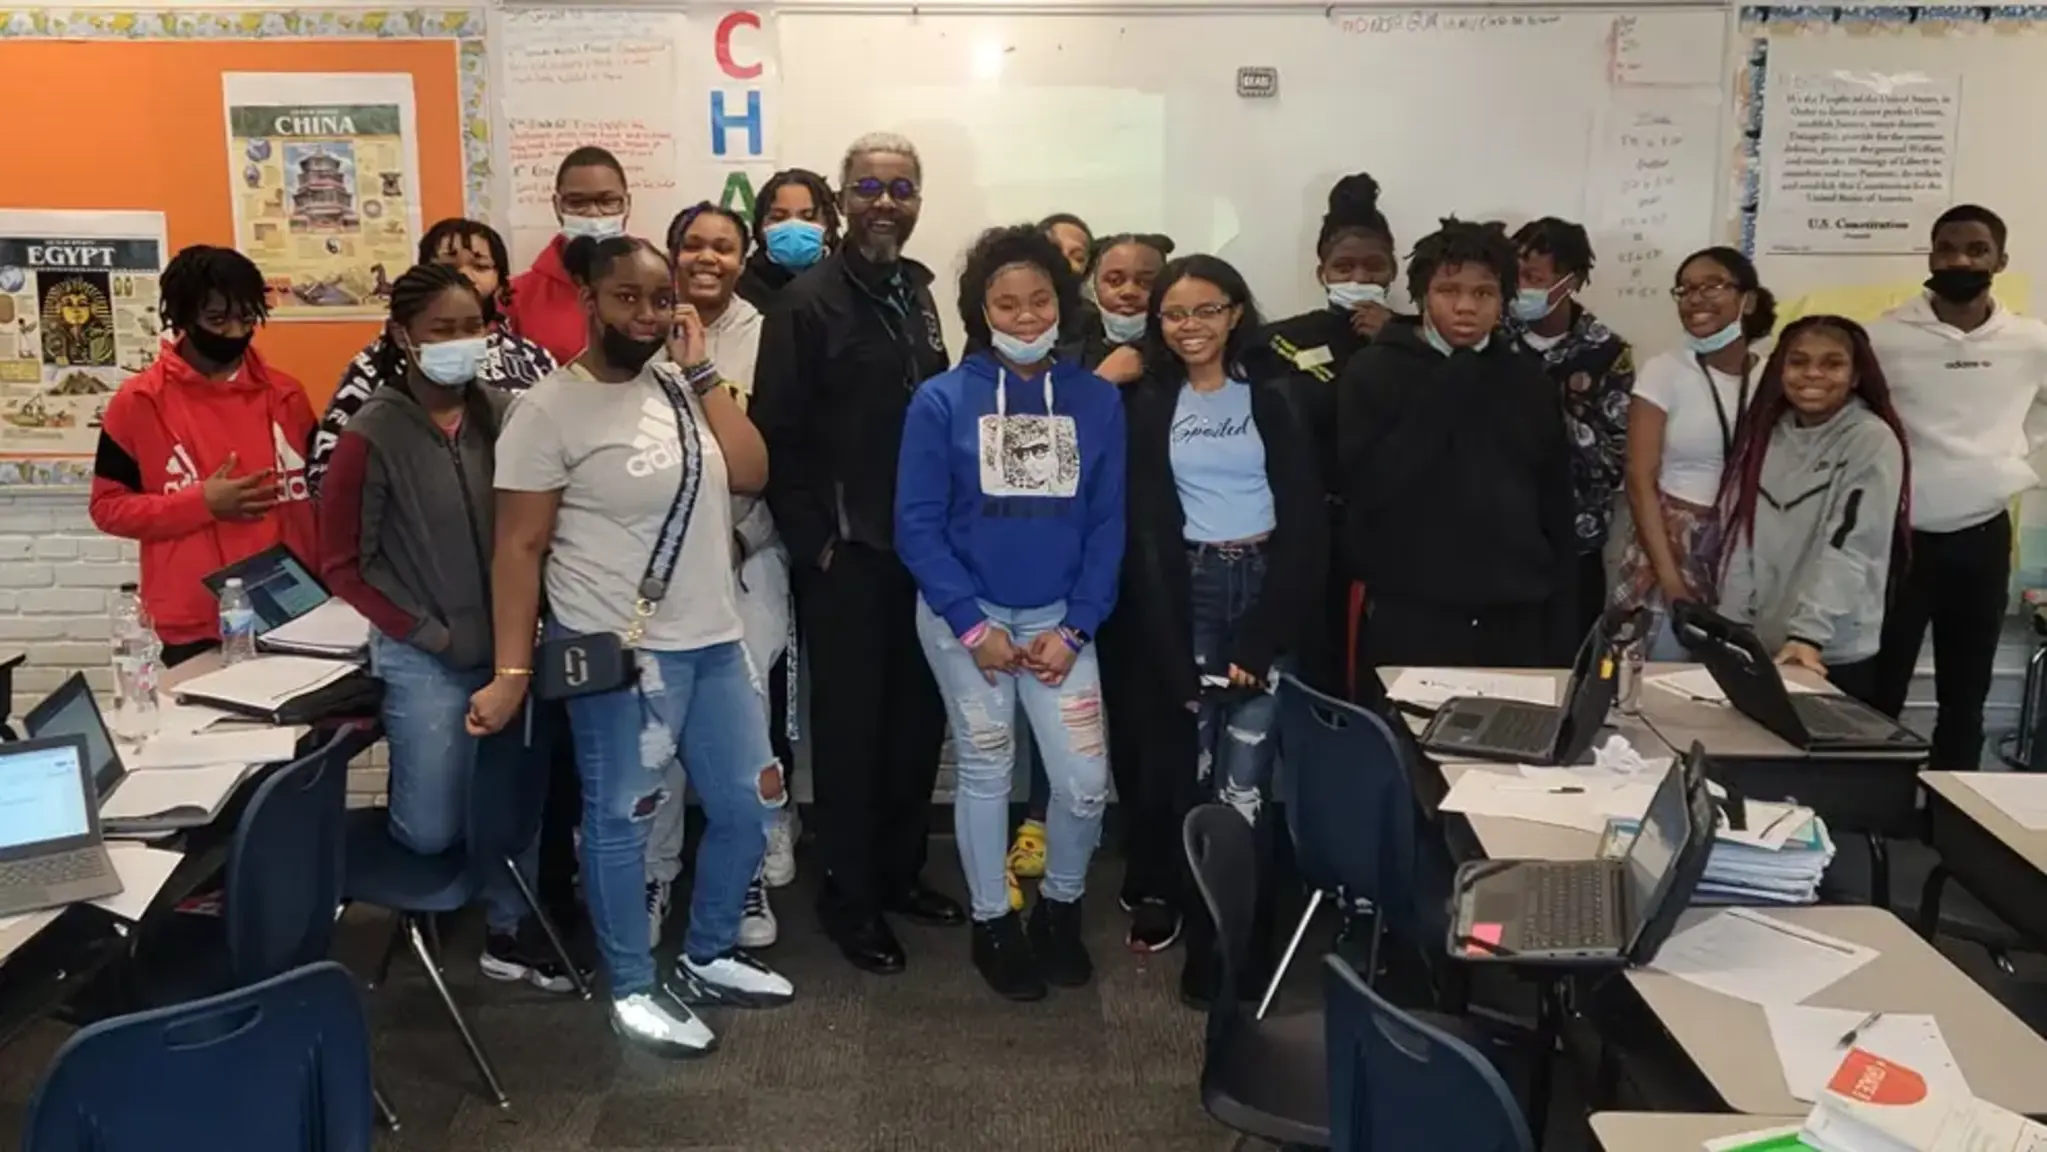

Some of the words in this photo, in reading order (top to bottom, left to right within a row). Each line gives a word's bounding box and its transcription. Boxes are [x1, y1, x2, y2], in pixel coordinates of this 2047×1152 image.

[274, 116, 357, 135] CHINA
[27, 245, 116, 266] EGYPT
[1171, 414, 1252, 444] Spoiled
